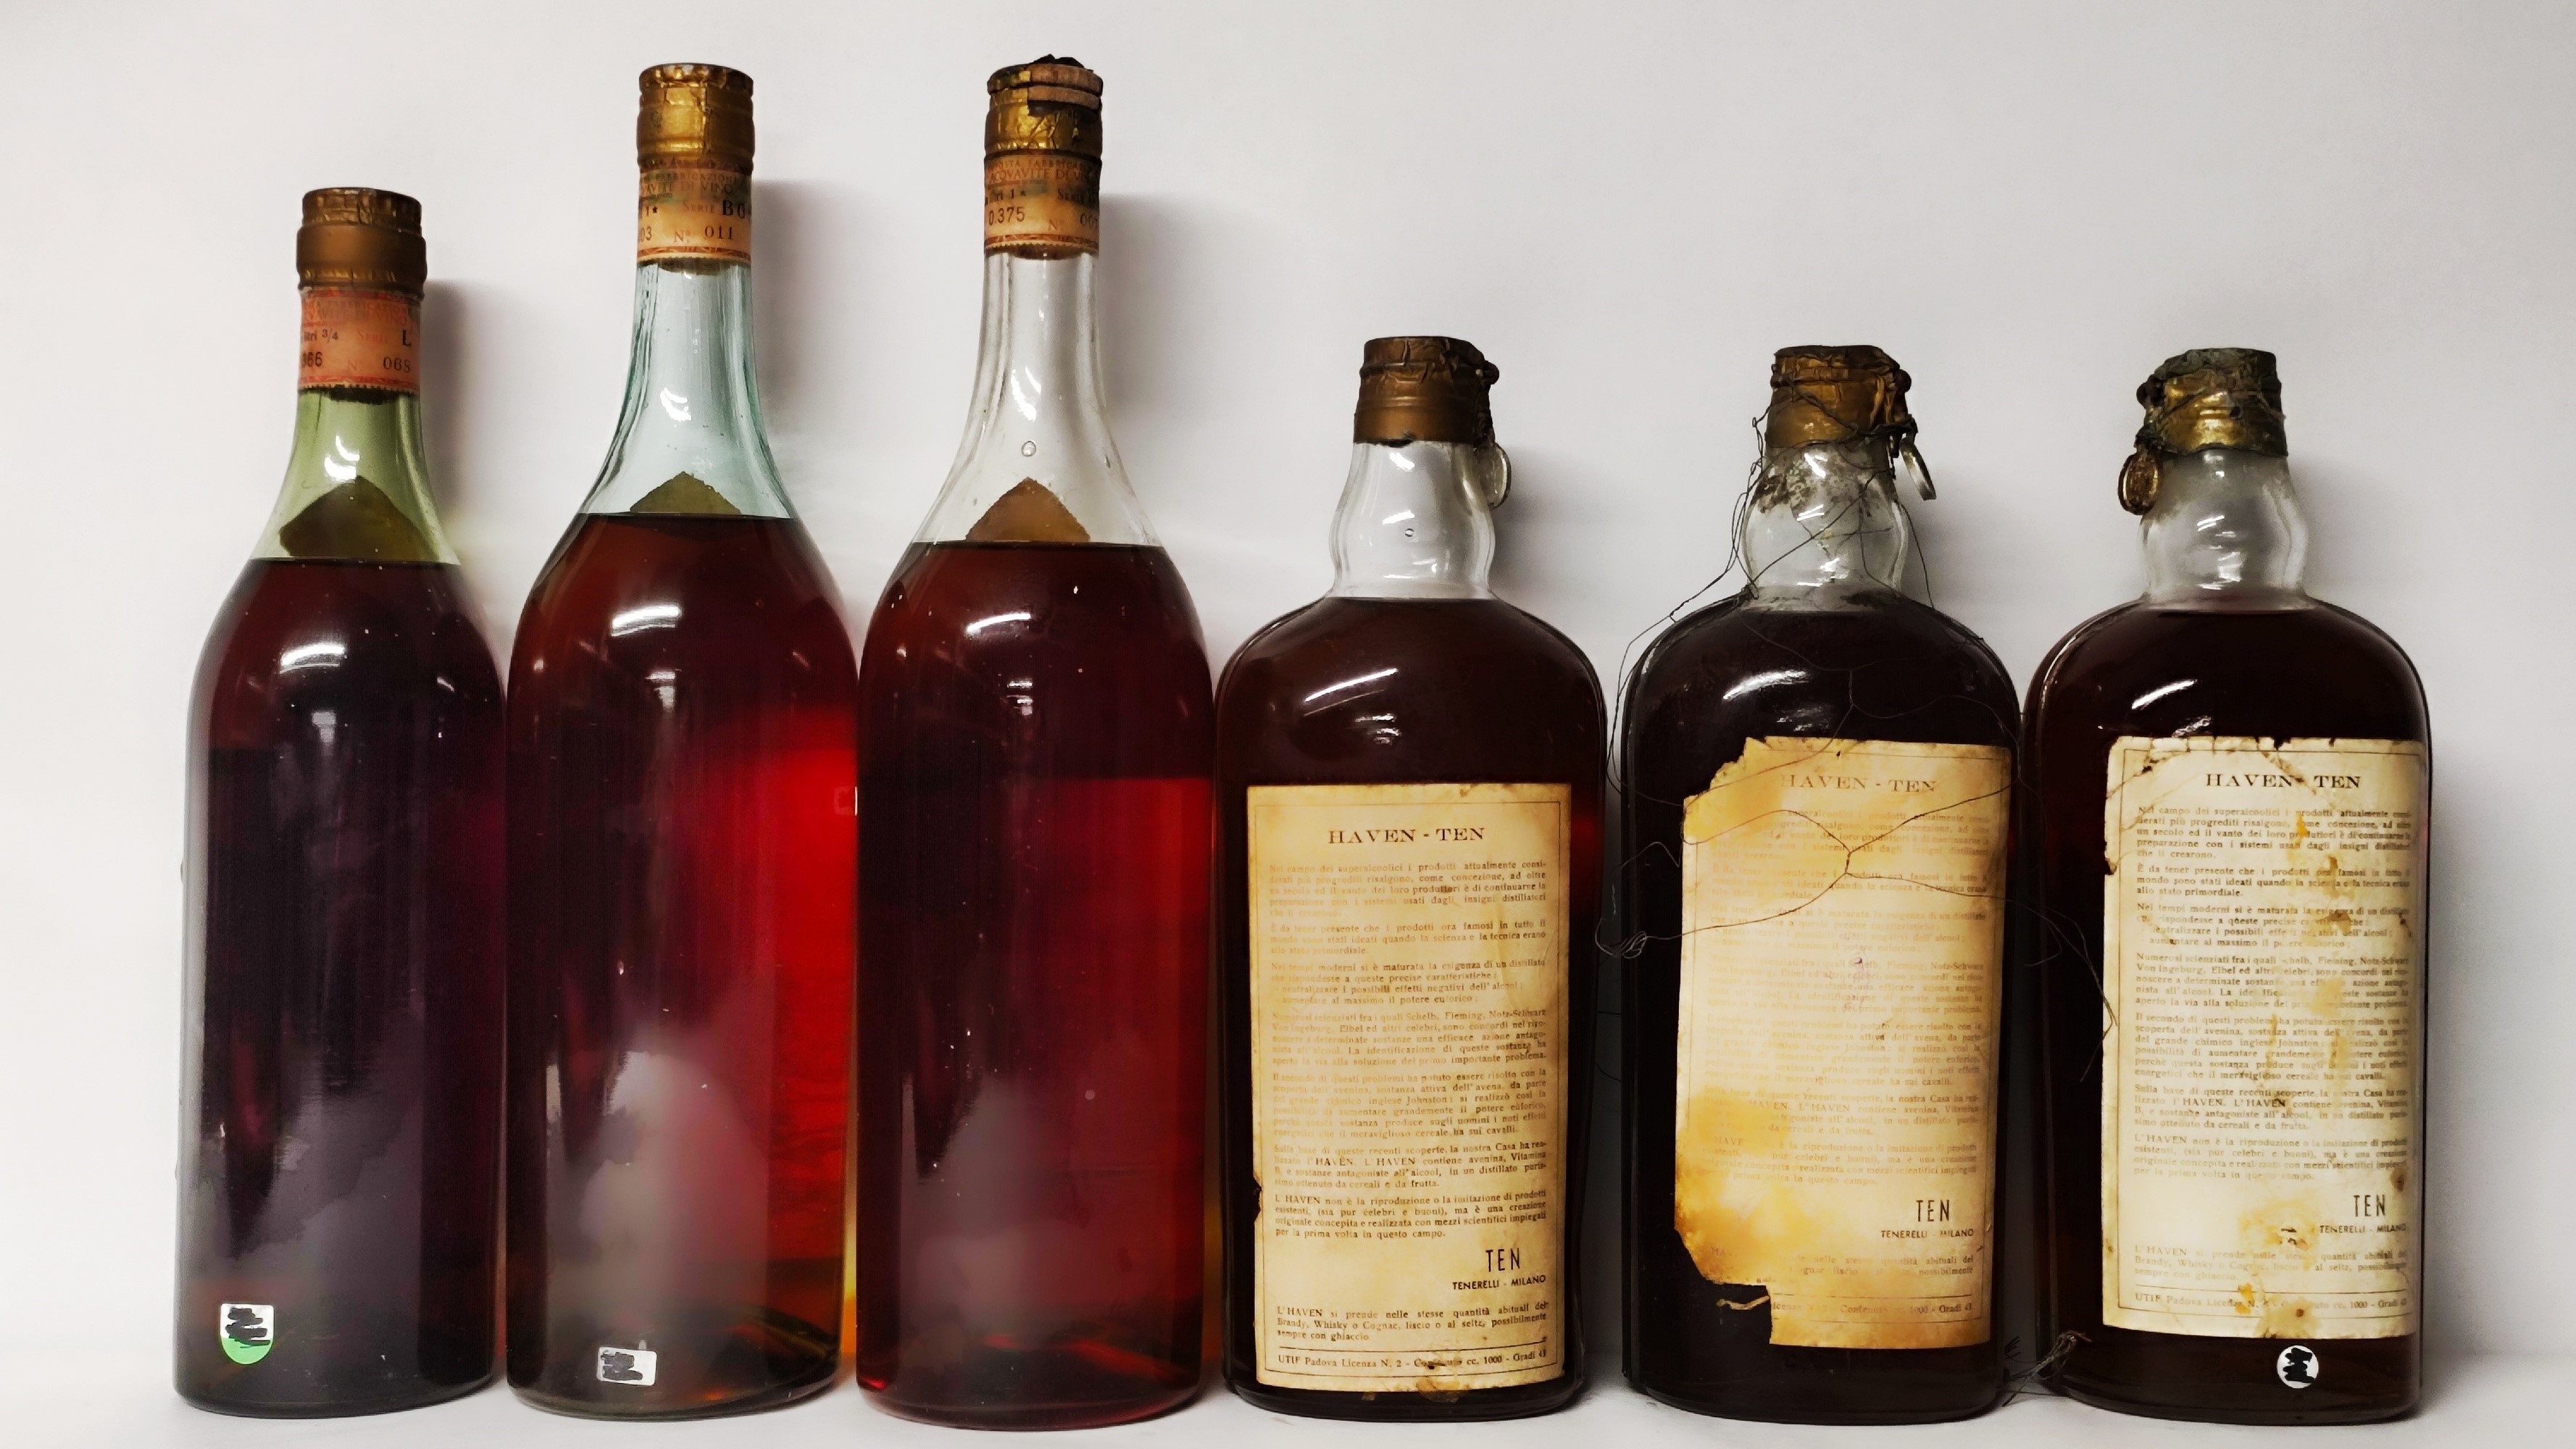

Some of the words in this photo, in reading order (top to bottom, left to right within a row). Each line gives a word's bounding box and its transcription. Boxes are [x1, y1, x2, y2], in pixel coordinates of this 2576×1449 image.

[1781, 774, 1868, 789] HAVEN
[1888, 780, 1937, 793] TEN
[2205, 773, 2292, 788] HAVEN
[2314, 775, 2361, 788] TEN
[1328, 829, 1417, 844] HAVEN
[1435, 827, 1485, 842] TEN
[1916, 1199, 1950, 1223] TEN
[2353, 1195, 2385, 1217] TEN
[1485, 1248, 1520, 1272] TEN
[1452, 1280, 1499, 1290] TENERELLI
[1511, 1274, 1546, 1287] MILANO
[1385, 1310, 1409, 1319] nelle
[1454, 1308, 1490, 1318] quantità
[1305, 1357, 1337, 1366] Padova
[1484, 1355, 1502, 1364] 1000
[1513, 1352, 1535, 1362] Gradi
